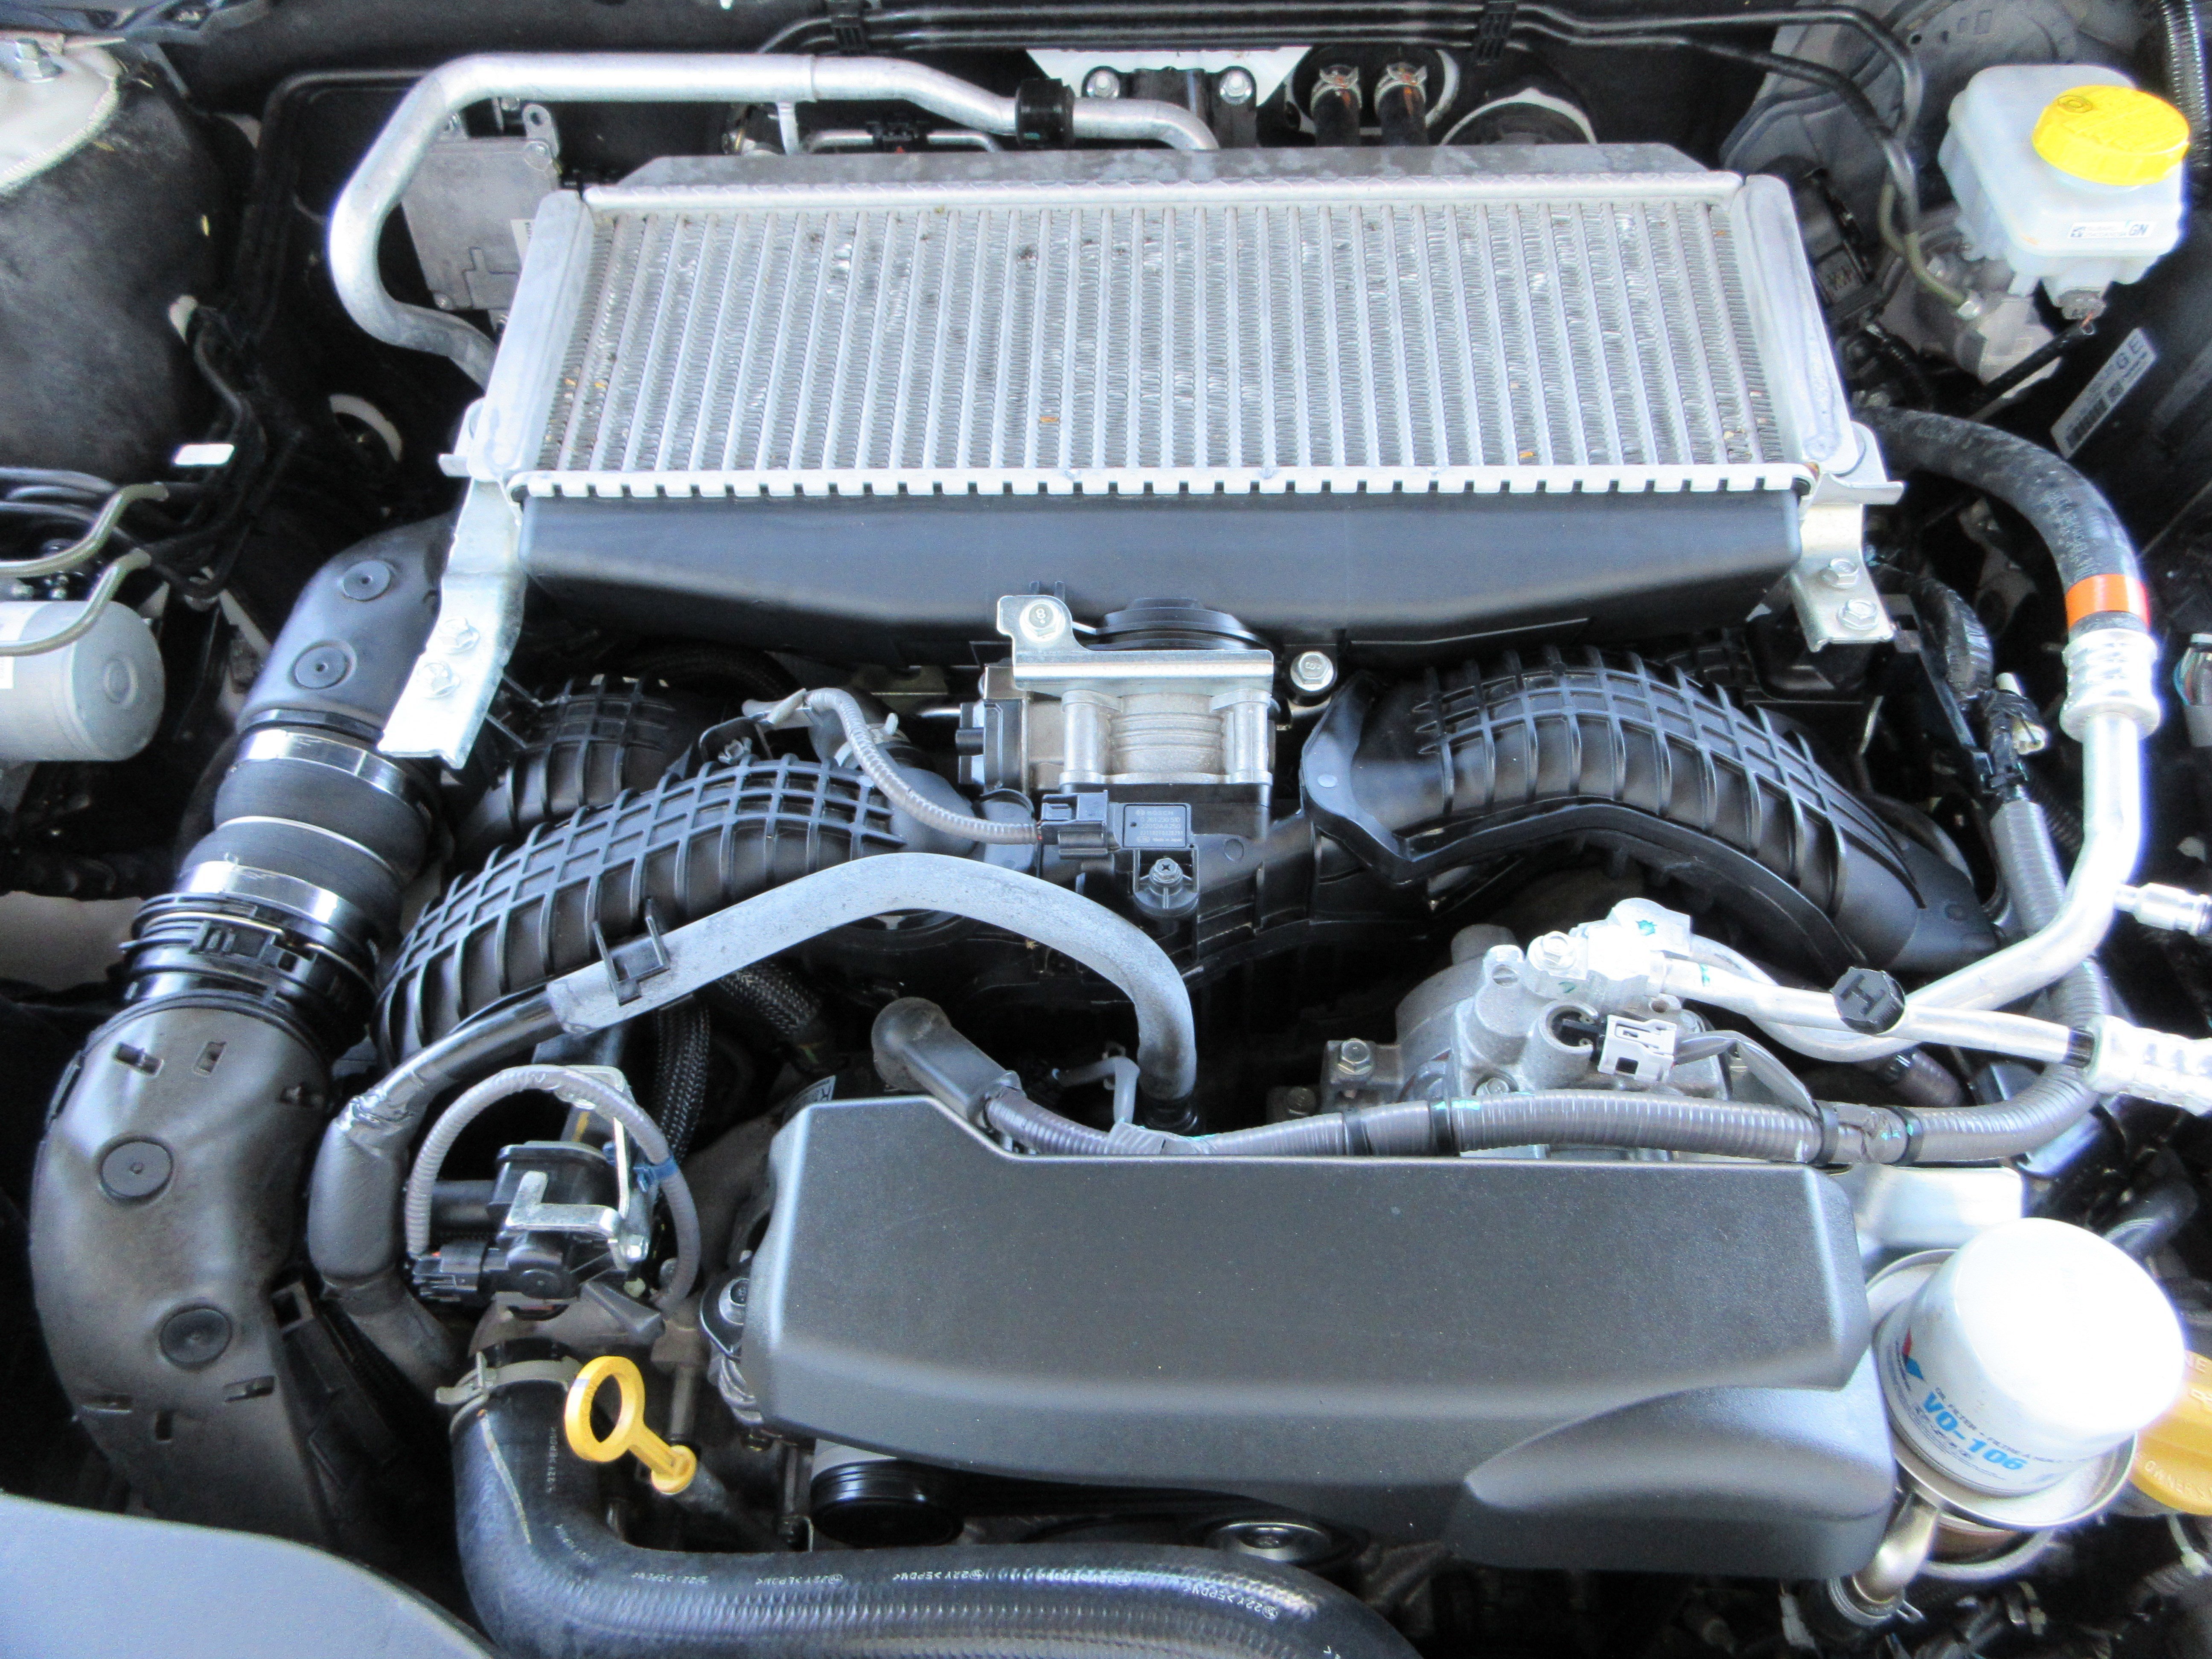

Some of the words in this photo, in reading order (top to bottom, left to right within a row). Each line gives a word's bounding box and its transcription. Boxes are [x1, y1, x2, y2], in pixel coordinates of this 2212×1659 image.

[1036, 608, 1046, 619] 8
[1839, 973, 1886, 1016] H
[1923, 1391, 2029, 1470] VO-106
[1947, 1403, 1977, 1430] FILTER
